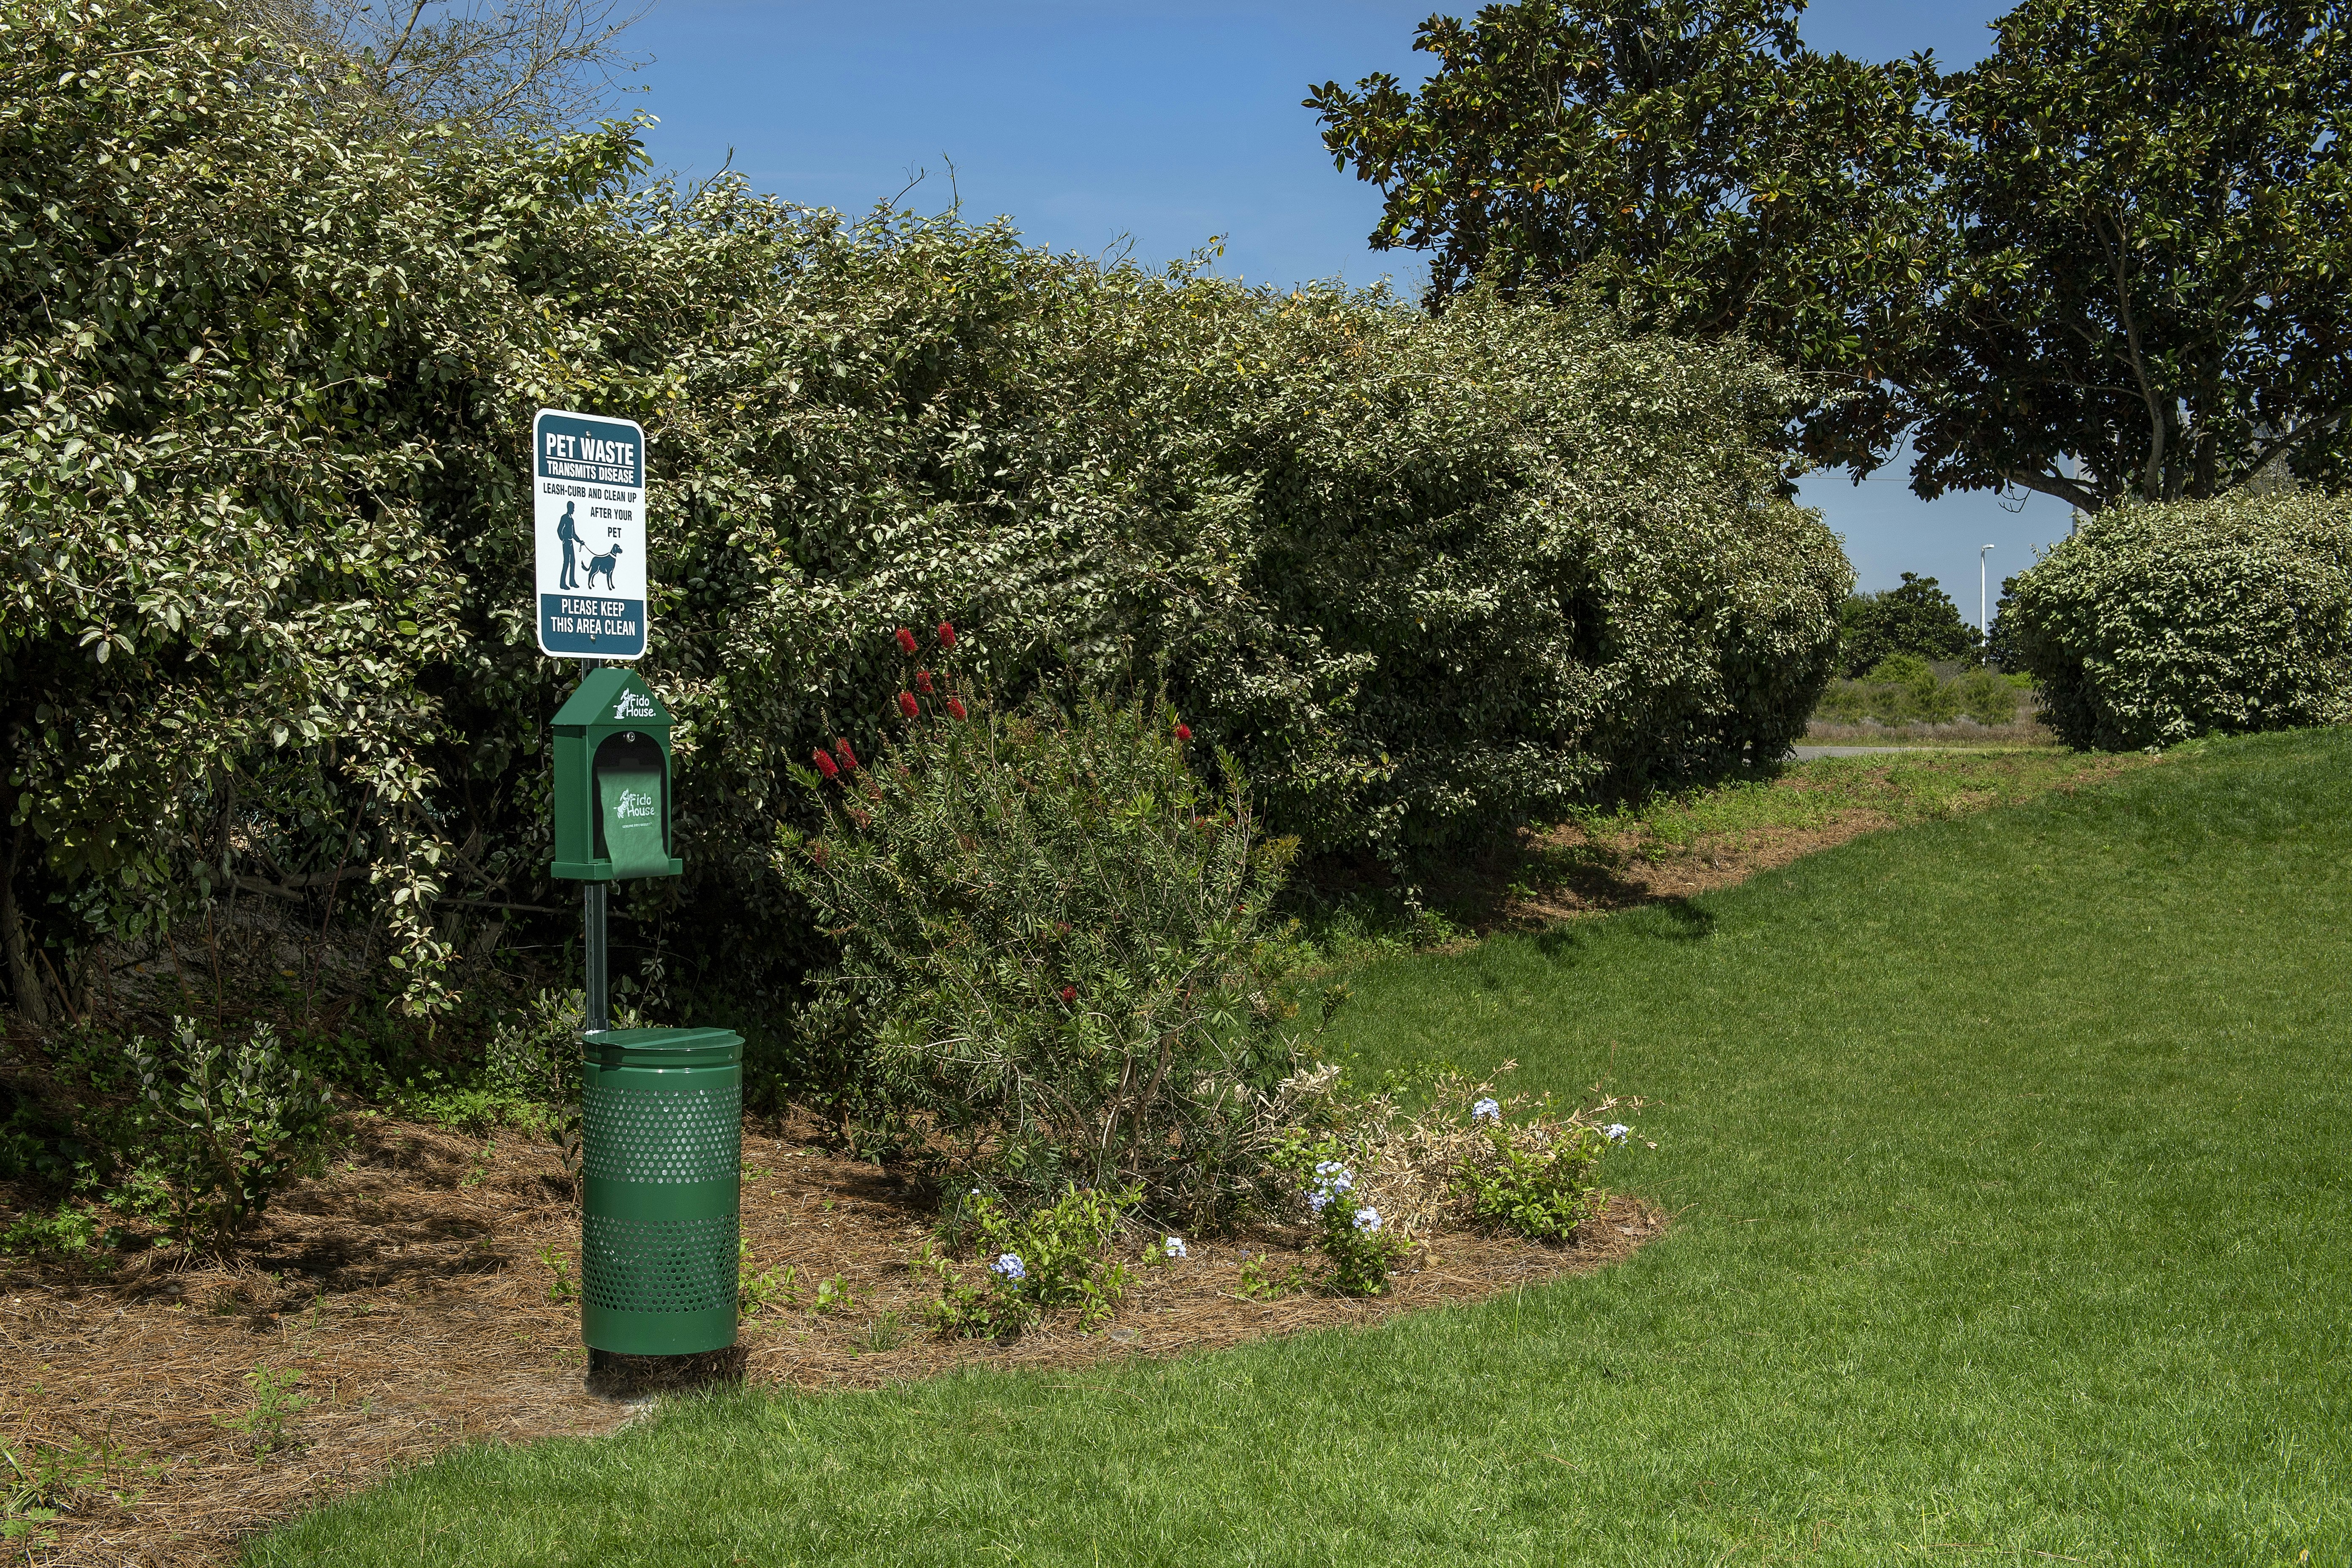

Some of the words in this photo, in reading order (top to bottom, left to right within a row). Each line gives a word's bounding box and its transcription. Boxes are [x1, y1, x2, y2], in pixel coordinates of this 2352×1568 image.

[546, 433, 575, 458] PET
[580, 437, 634, 466] WASTE
[547, 460, 596, 479] TRANSMITS
[599, 466, 634, 484] DISEASE
[543, 482, 586, 497] LEASH-CURB
[588, 488, 602, 499] AND
[604, 490, 625, 502] CLEAN
[628, 492, 637, 503] UP
[591, 506, 612, 519] AFTER
[614, 509, 632, 521] YOUR
[608, 527, 621, 538] PET
[561, 598, 598, 615] PLEASE
[601, 601, 625, 617] KEEP
[550, 616, 573, 633] THIS
[576, 618, 602, 634] AREA
[604, 619, 635, 636] CLEAN
[630, 694, 650, 706] Fido
[626, 705, 653, 717] House
[630, 793, 651, 806] Fido
[627, 805, 655, 817] House
